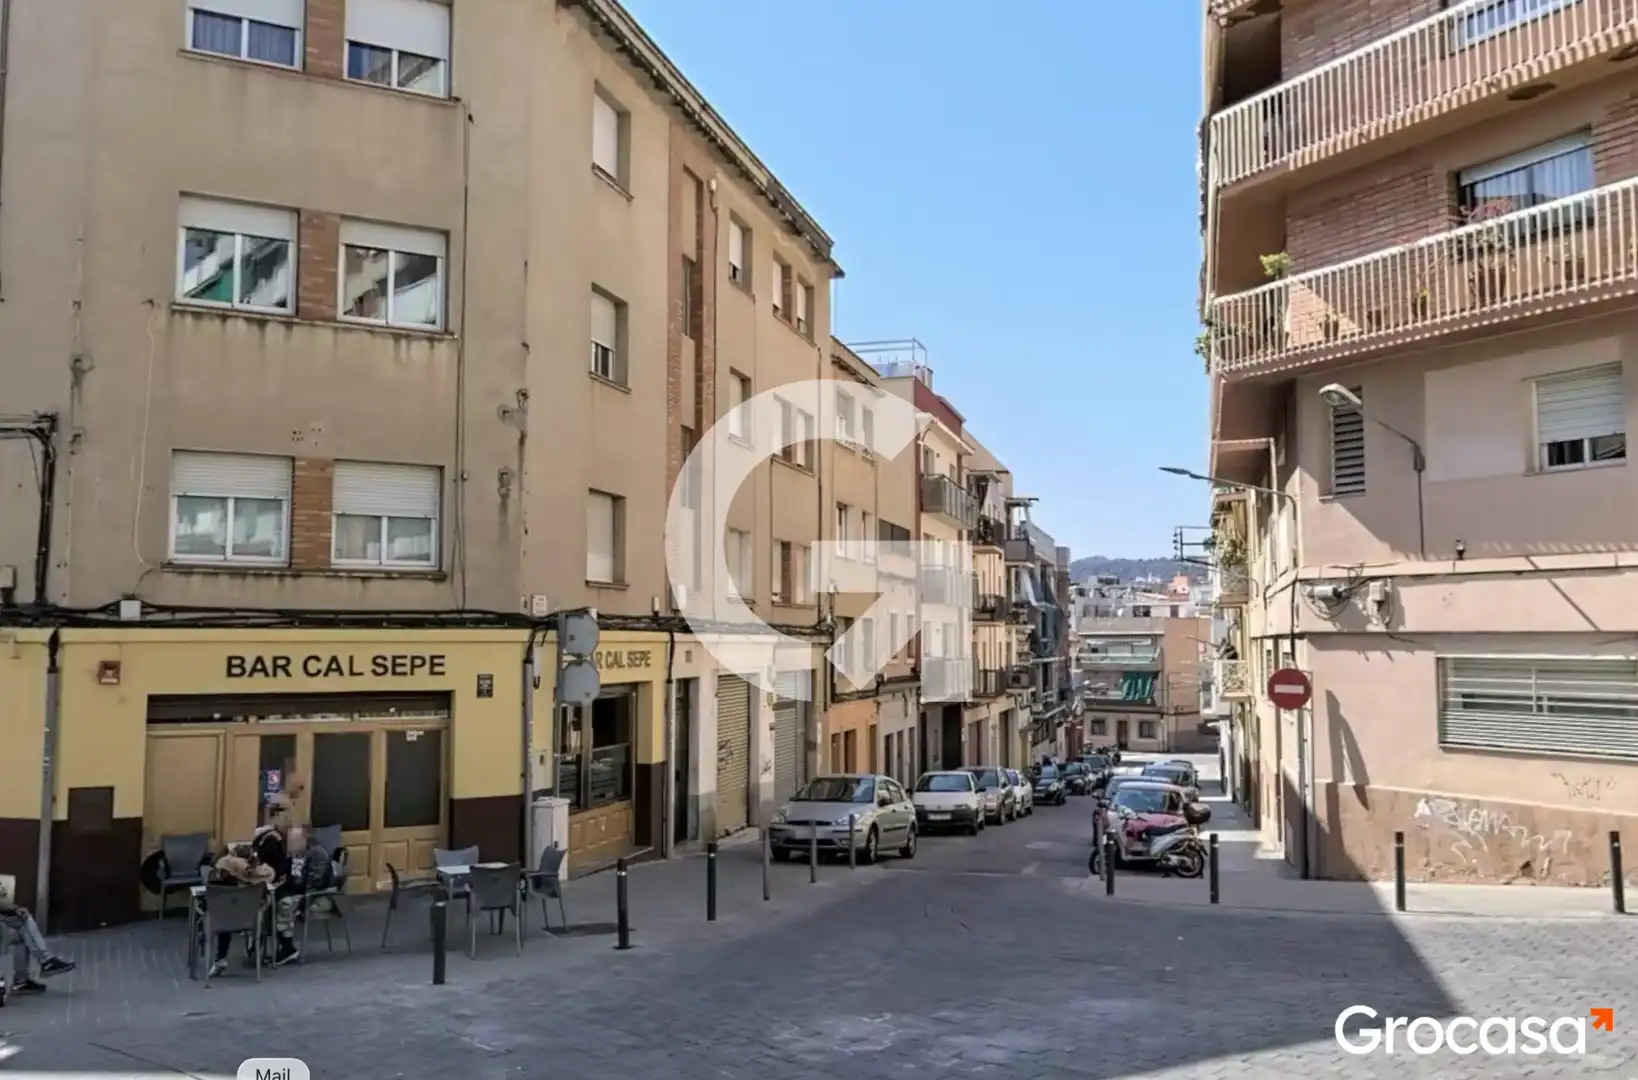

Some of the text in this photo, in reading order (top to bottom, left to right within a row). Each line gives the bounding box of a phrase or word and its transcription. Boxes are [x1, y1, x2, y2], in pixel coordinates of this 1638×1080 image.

[226, 655, 446, 678] BAR CAL SEPE
[605, 650, 626, 669] CAL
[627, 650, 652, 669] SEPE
